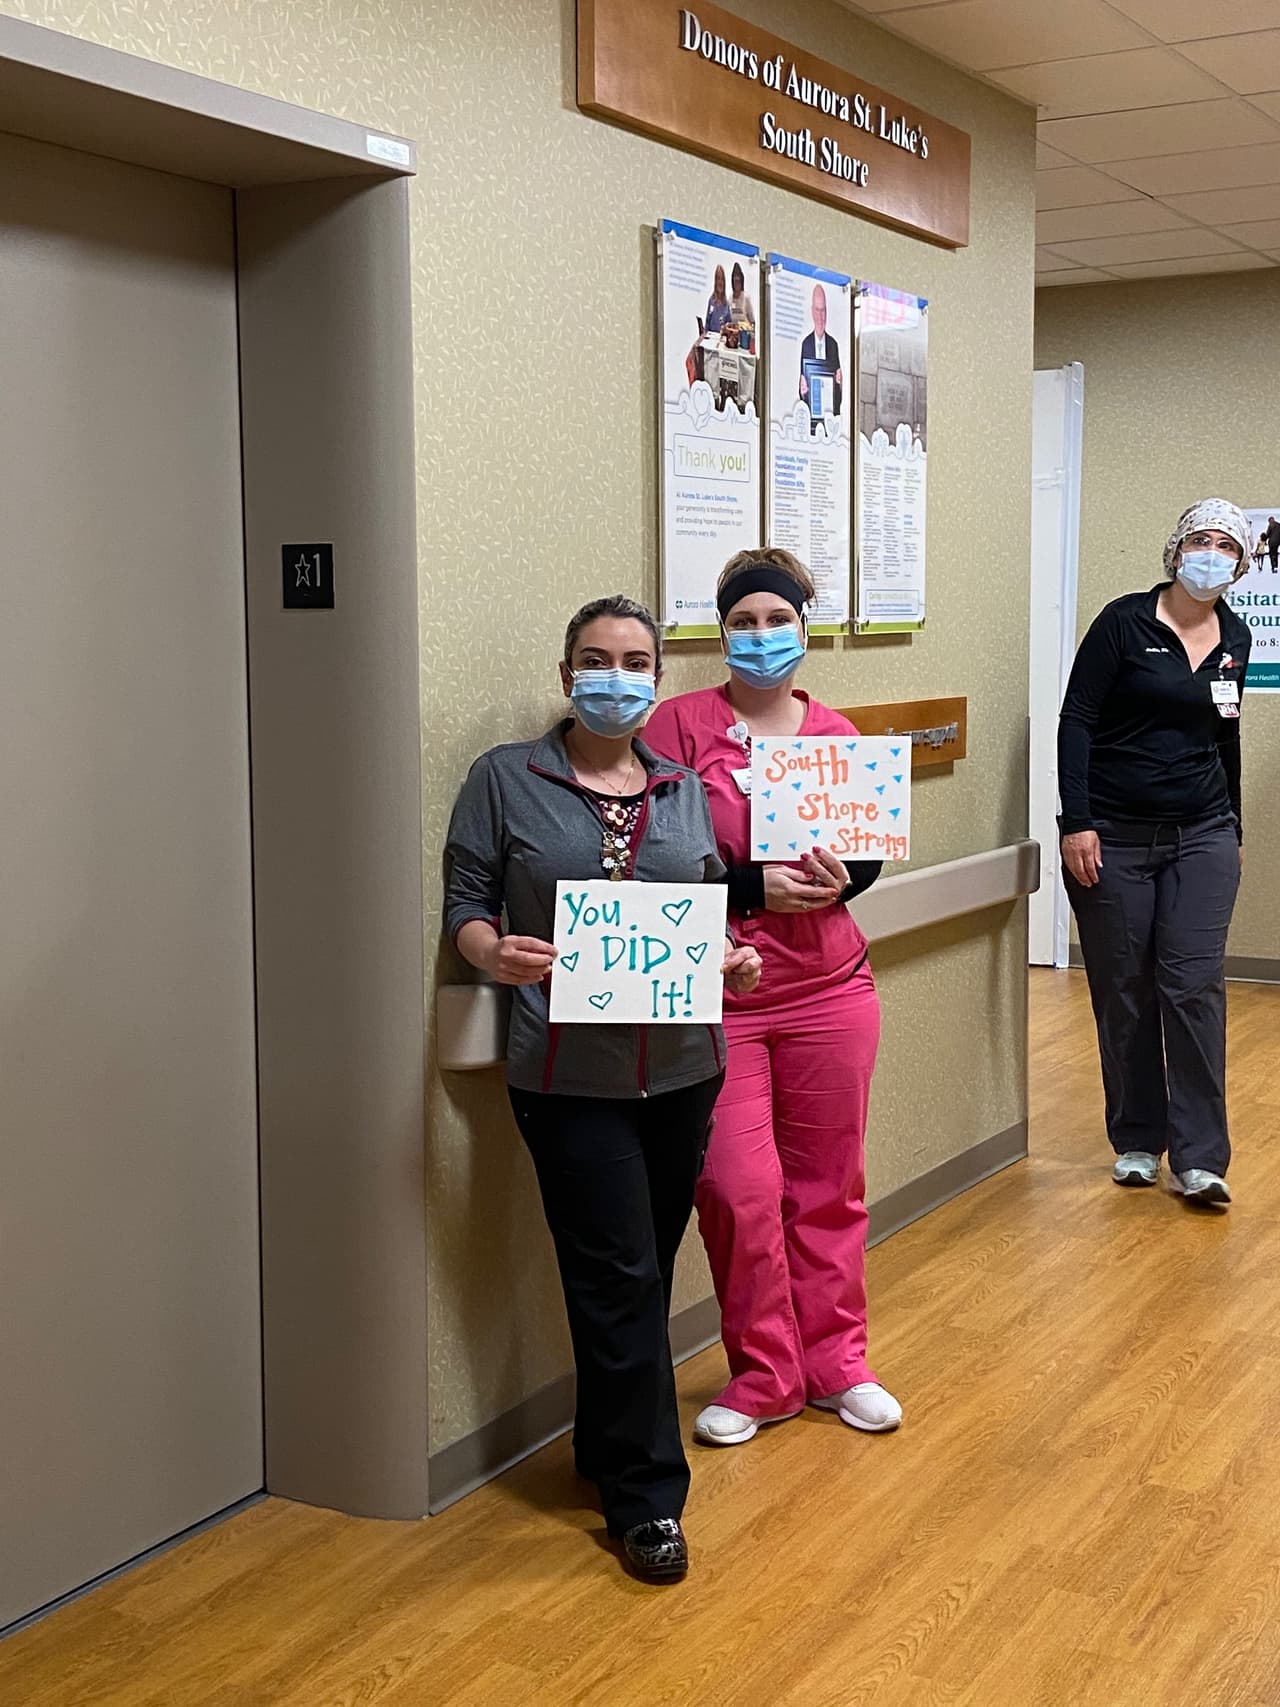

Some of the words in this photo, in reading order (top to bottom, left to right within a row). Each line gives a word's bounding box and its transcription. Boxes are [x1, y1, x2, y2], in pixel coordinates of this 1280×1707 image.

[682, 9, 758, 80] Donors
[763, 55, 784, 91] of
[785, 62, 849, 122] Aurora
[854, 93, 874, 133] St.
[879, 105, 929, 160] Luke's
[763, 111, 816, 167] South
[820, 136, 869, 187] Shore
[677, 444, 716, 471] Thank
[719, 451, 747, 474] you!
[1256, 639, 1266, 648] to
[765, 744, 849, 787] South
[797, 792, 879, 823] Shore
[829, 826, 907, 861] Strong
[562, 892, 621, 936] You
[651, 973, 695, 1018] It!
